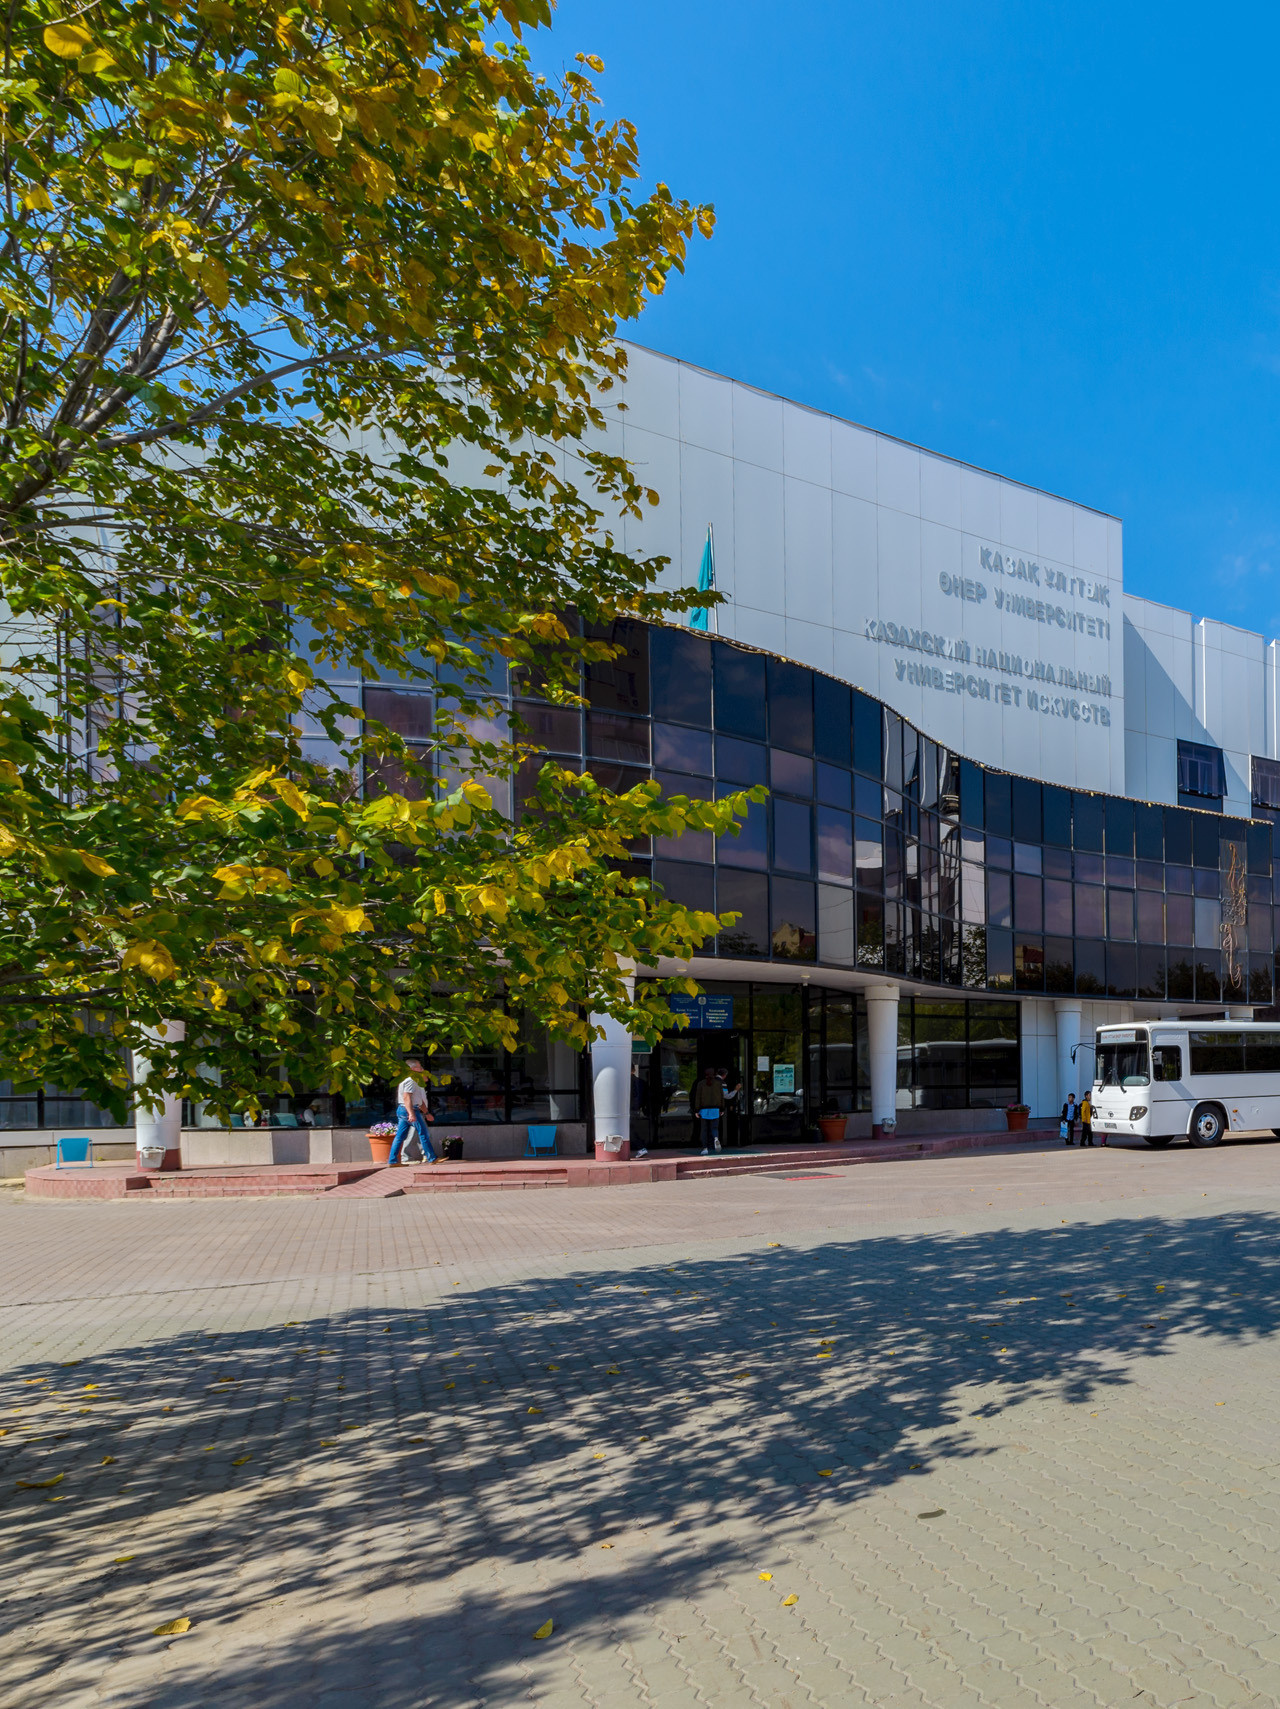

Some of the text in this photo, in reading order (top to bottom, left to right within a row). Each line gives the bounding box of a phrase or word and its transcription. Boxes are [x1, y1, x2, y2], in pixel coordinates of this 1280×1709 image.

[938, 571, 987, 604] ӨНЕР
[864, 618, 1112, 698] КАЗАХСКИЙ НАЦИОНАЛЬНЫЙ
[894, 658, 1111, 727] УНИВЕРСИТЕТ ИСКУССТВ
